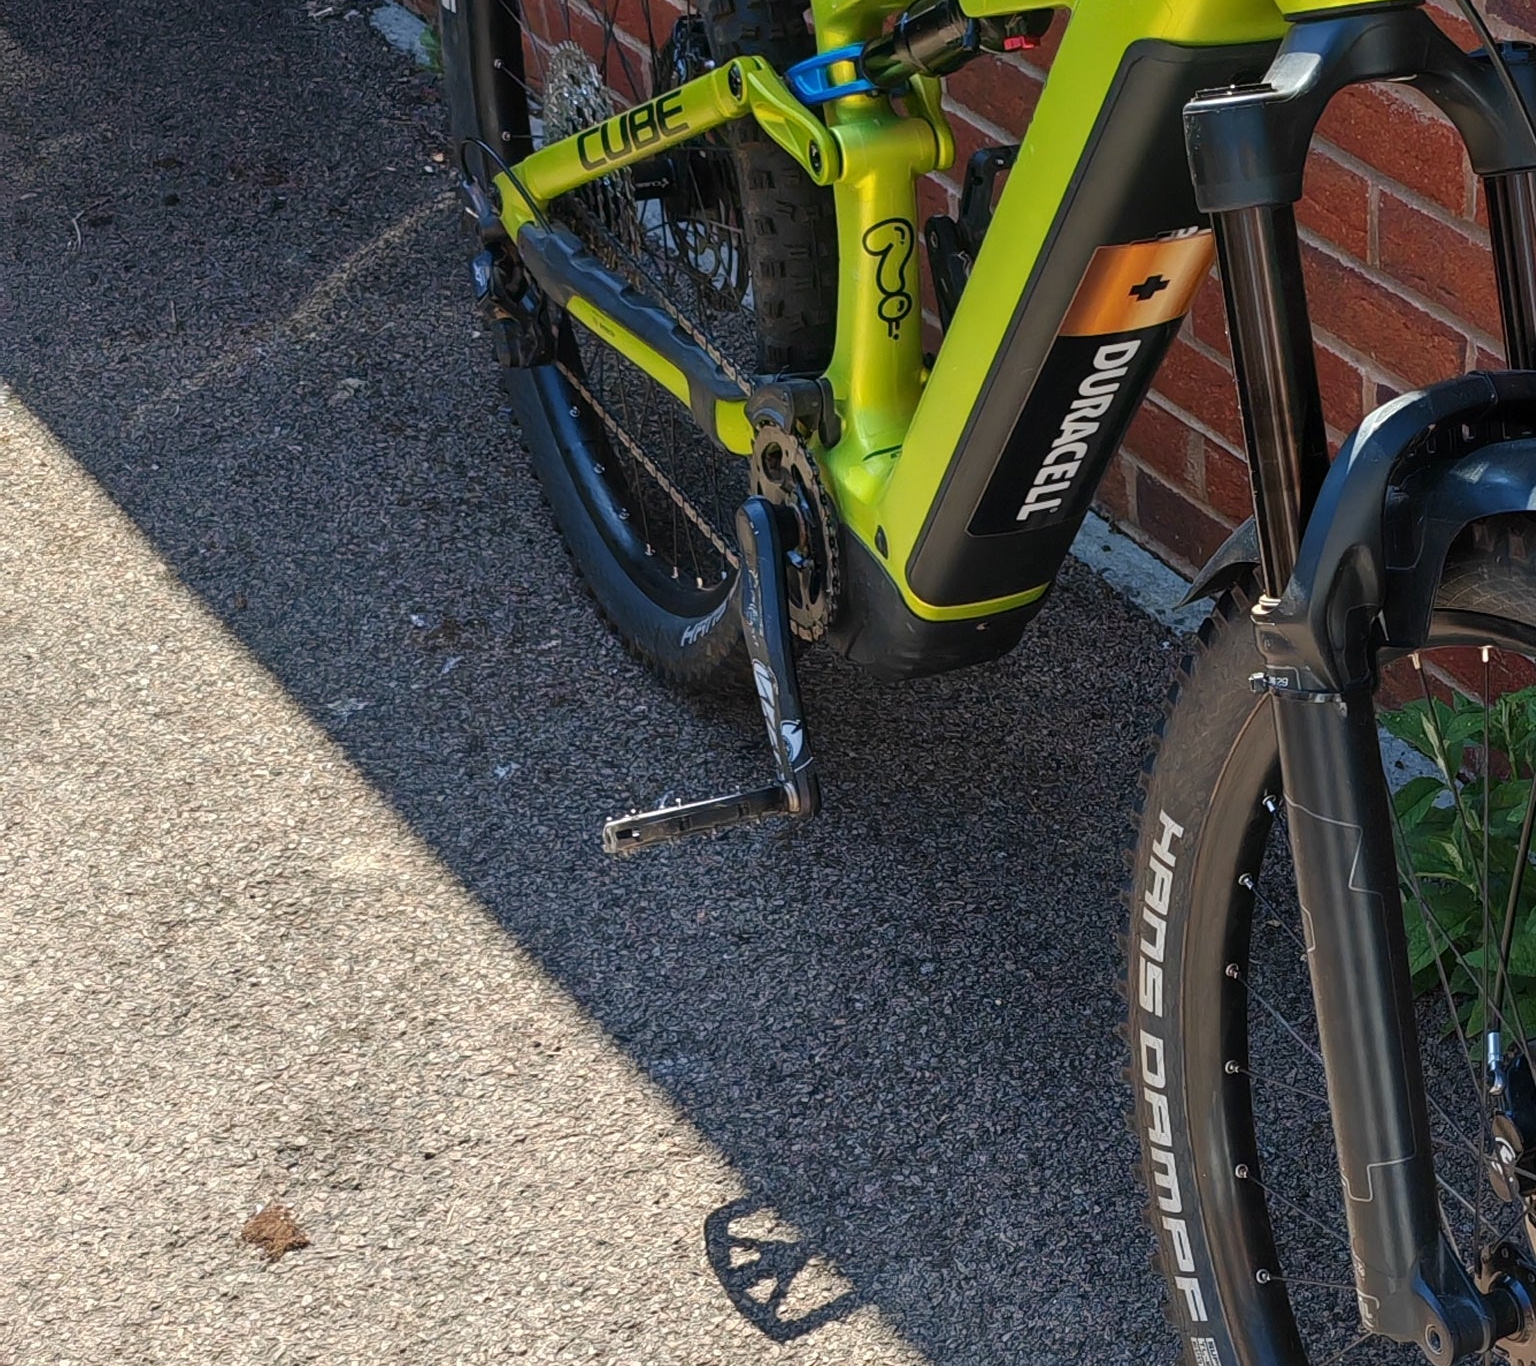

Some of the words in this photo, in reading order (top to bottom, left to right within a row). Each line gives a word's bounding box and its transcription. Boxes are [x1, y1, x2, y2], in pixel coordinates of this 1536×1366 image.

[577, 89, 690, 171] CUBE
[1016, 339, 1142, 521] DURACELL
[1141, 809, 1184, 1018] HANS
[1140, 1030, 1208, 1322] DAMPF
